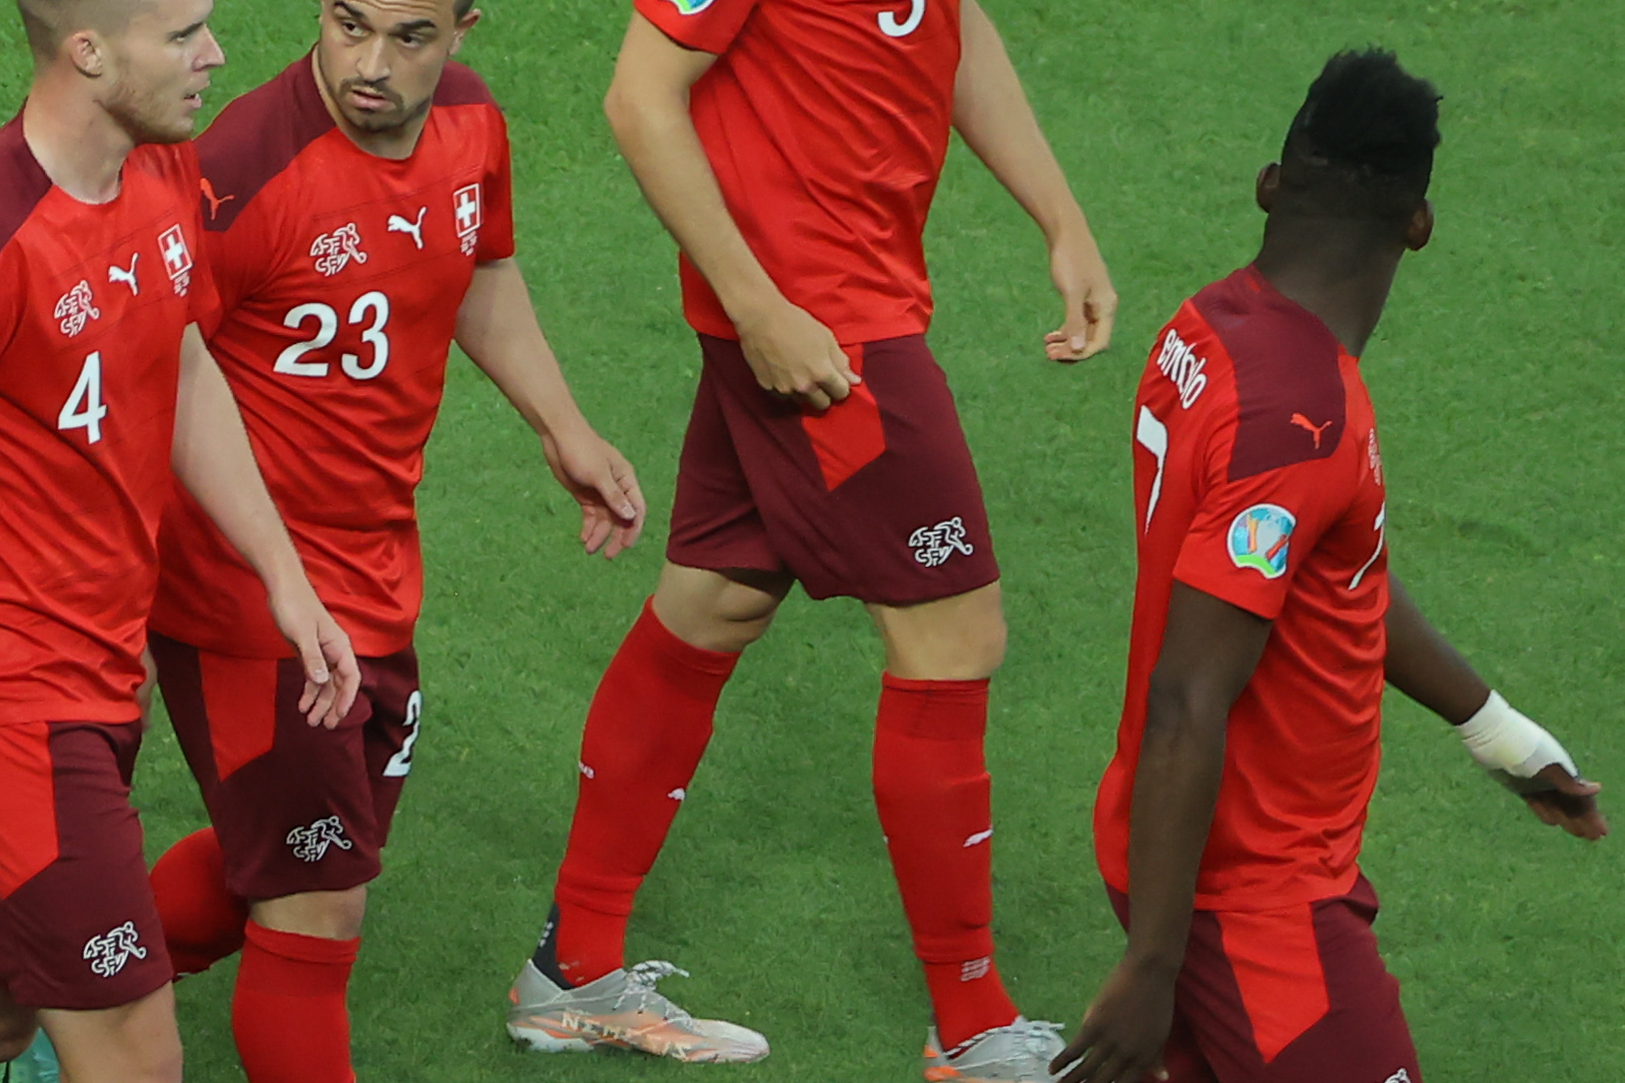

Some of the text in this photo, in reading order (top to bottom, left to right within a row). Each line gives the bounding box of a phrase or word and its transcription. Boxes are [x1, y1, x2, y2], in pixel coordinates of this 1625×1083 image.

[273, 291, 390, 381] 23
[57, 350, 107, 446] 4
[383, 690, 422, 778] 2
